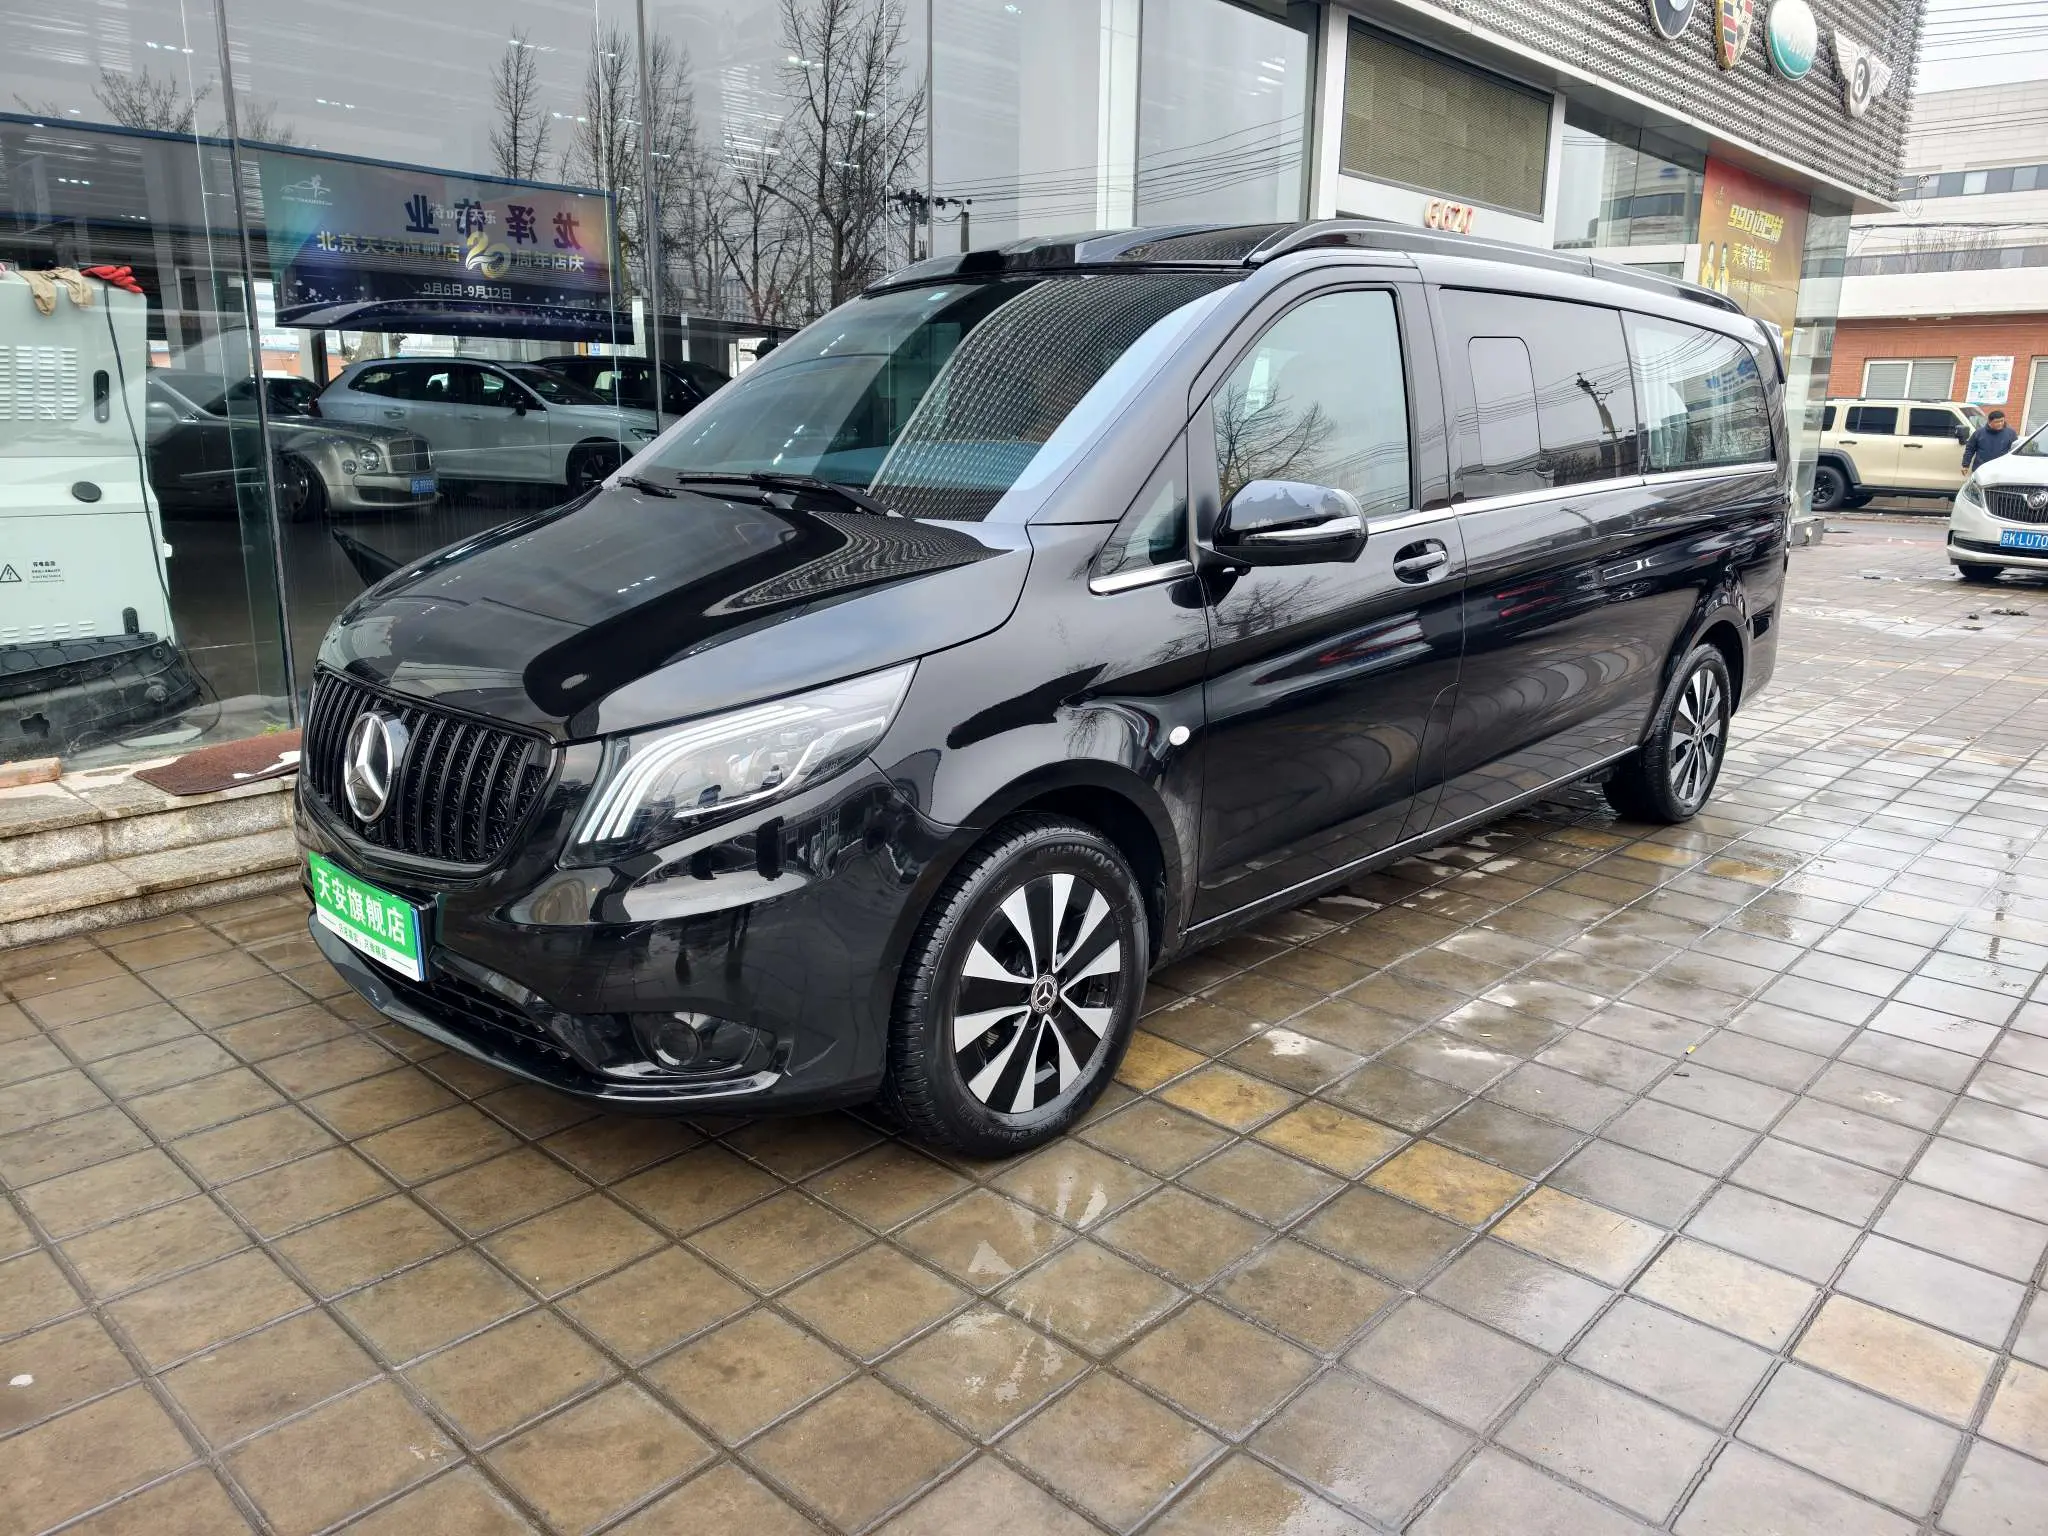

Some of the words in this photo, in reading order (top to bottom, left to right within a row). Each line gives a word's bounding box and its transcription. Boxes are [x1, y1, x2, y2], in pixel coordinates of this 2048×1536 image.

[423, 282, 513, 300] 9月6日-9月12日
[316, 867, 406, 947] 天安旗舰店
